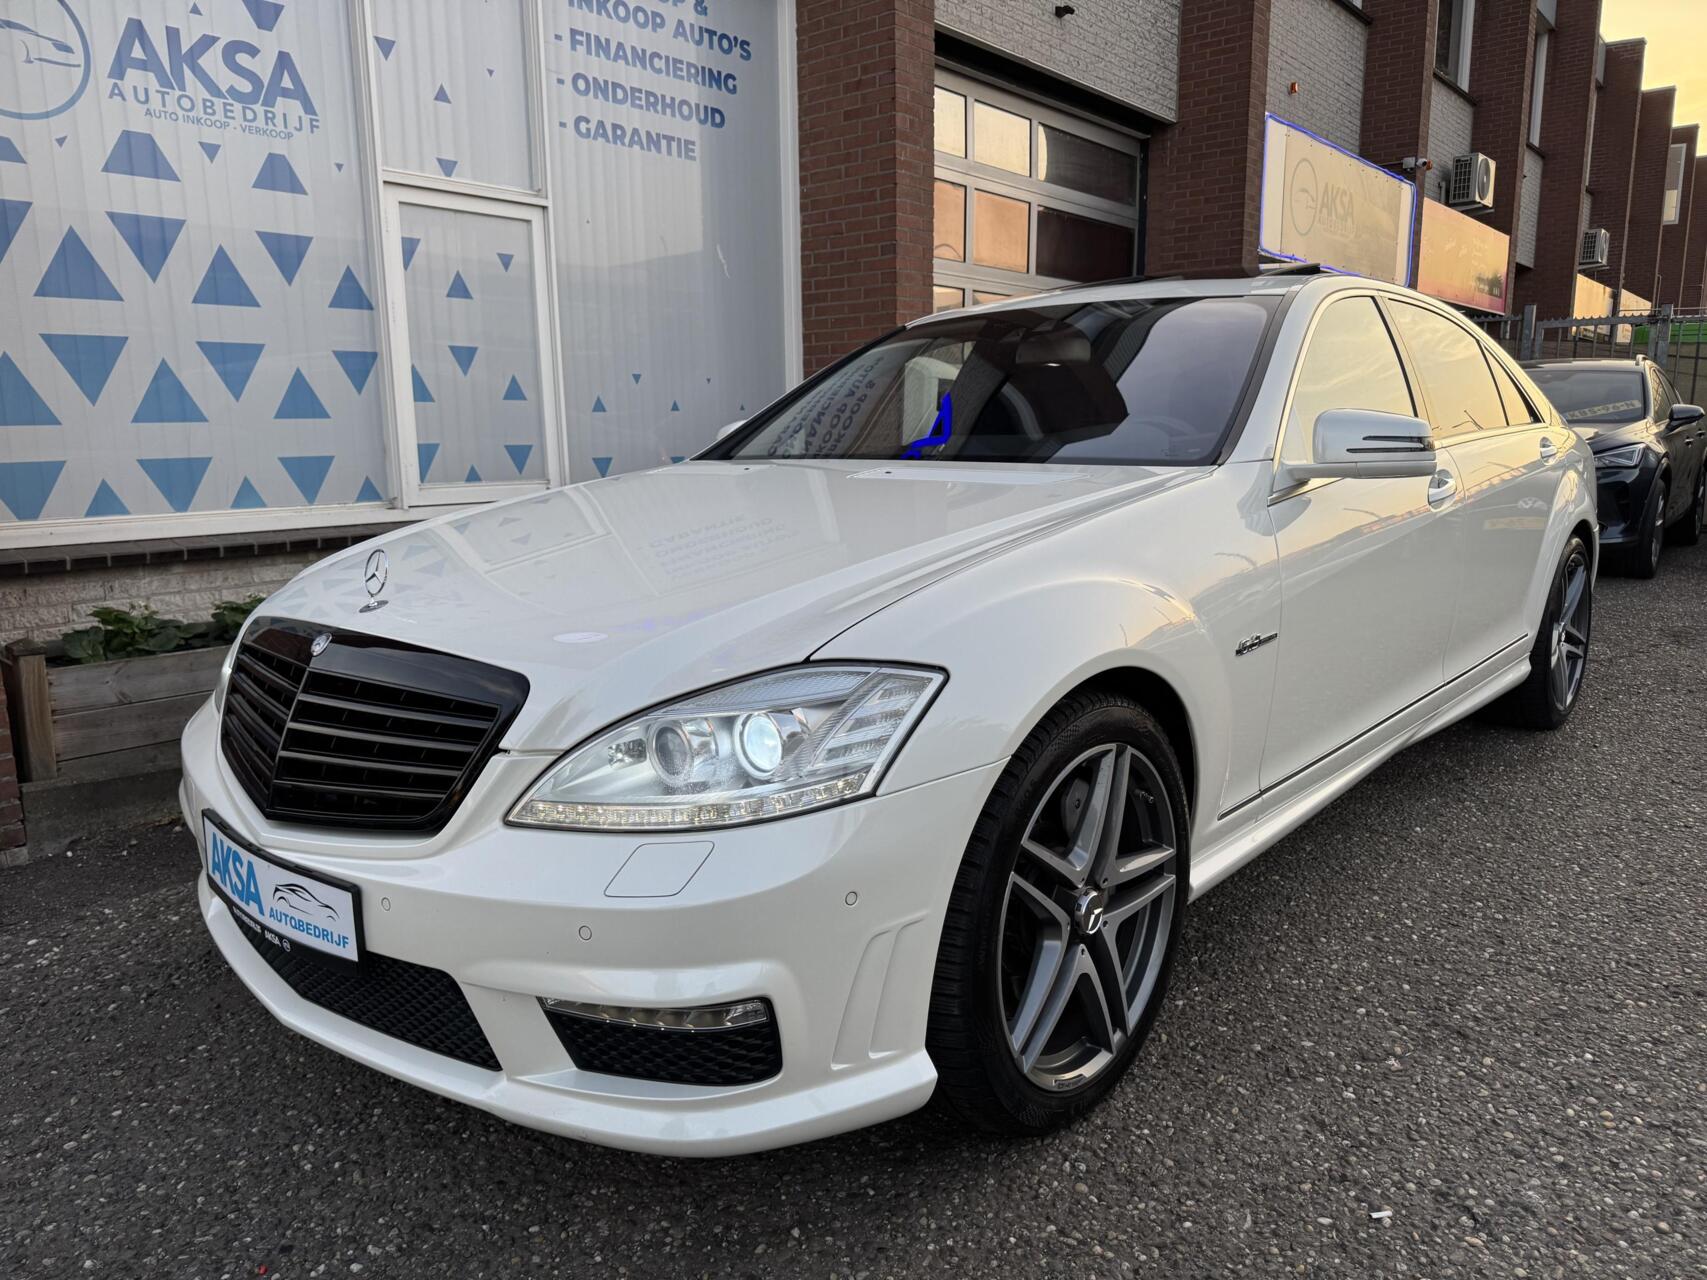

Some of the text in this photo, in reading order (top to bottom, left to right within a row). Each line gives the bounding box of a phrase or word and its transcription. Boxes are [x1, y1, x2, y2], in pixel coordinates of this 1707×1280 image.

[569, 27, 737, 95] FINANCIERING
[673, 19, 752, 61] AUTO'S
[107, 17, 318, 116] AKSA
[108, 82, 320, 134] AUTOBEDRIJF
[144, 107, 179, 121] AUTO
[183, 114, 230, 130] INKOOP
[240, 124, 294, 140] VERKOOP
[571, 72, 726, 129] ONDERHOUD
[574, 115, 696, 161] GARANTIE
[1319, 182, 1354, 225] AKSA
[211, 832, 265, 917] AKSA
[269, 907, 349, 948] AUTOBEDRIJF
